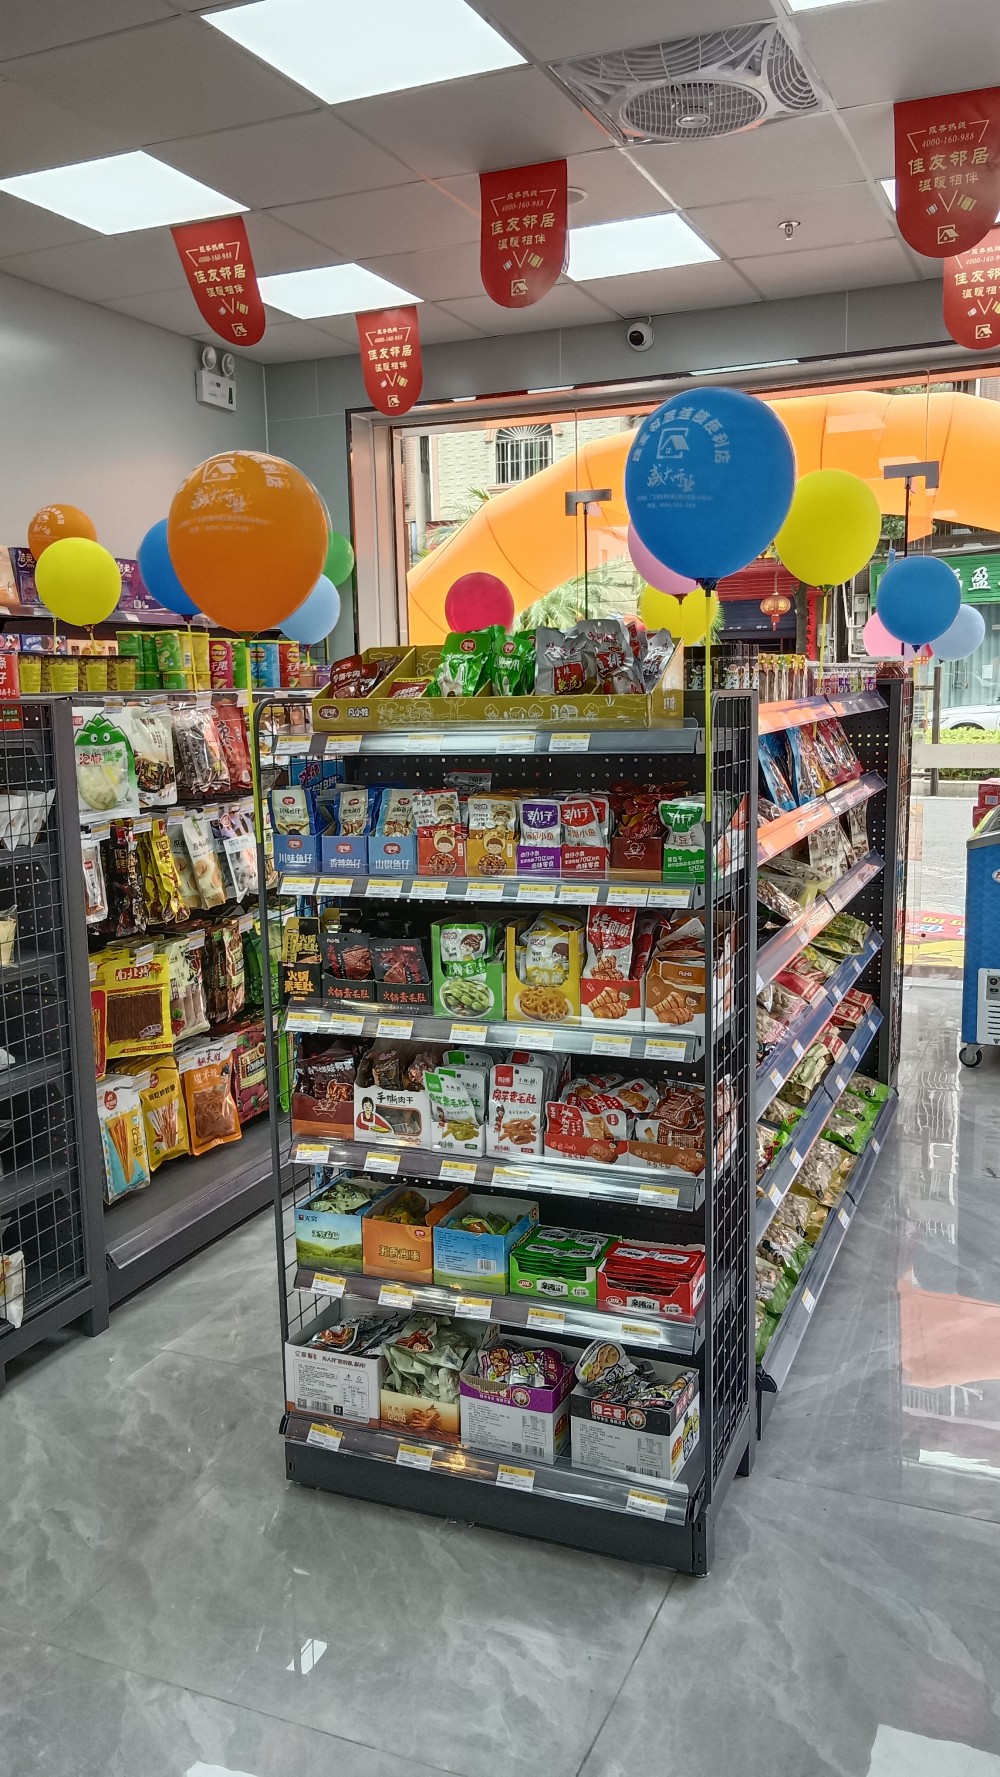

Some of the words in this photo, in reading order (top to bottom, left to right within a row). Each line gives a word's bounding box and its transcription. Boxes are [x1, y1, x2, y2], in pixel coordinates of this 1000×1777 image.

[928, 121, 967, 135] 服务热线
[921, 132, 975, 148] 4000-160-988
[907, 146, 990, 176] 佳友邻居
[917, 172, 979, 192] 温暖相伴
[501, 199, 545, 212] 4000-160-988
[490, 212, 556, 236] 佳友邻居
[497, 233, 546, 250] 温暖相伴
[193, 263, 246, 285] 佳友邻居
[206, 283, 244, 298] 温暖相伴
[367, 344, 413, 362] 佳友邻居
[374, 360, 408, 373] 温暖相伴
[526, 808, 554, 827] 劲仔
[563, 806, 589, 825] 劲仔
[278, 852, 313, 864] 川味鱼仔
[329, 857, 361, 869] 香辣鱼仔
[375, 859, 410, 870] 山椒鱼仔
[287, 970, 310, 982] 火锅
[284, 980, 315, 993] 素毛肚
[327, 986, 369, 999] 火锅素毛肚
[383, 991, 427, 1003] 火锅素毛肚
[376, 1091, 414, 1105] 手撕肉干
[492, 1088, 537, 1105] 魔芋素毛肚
